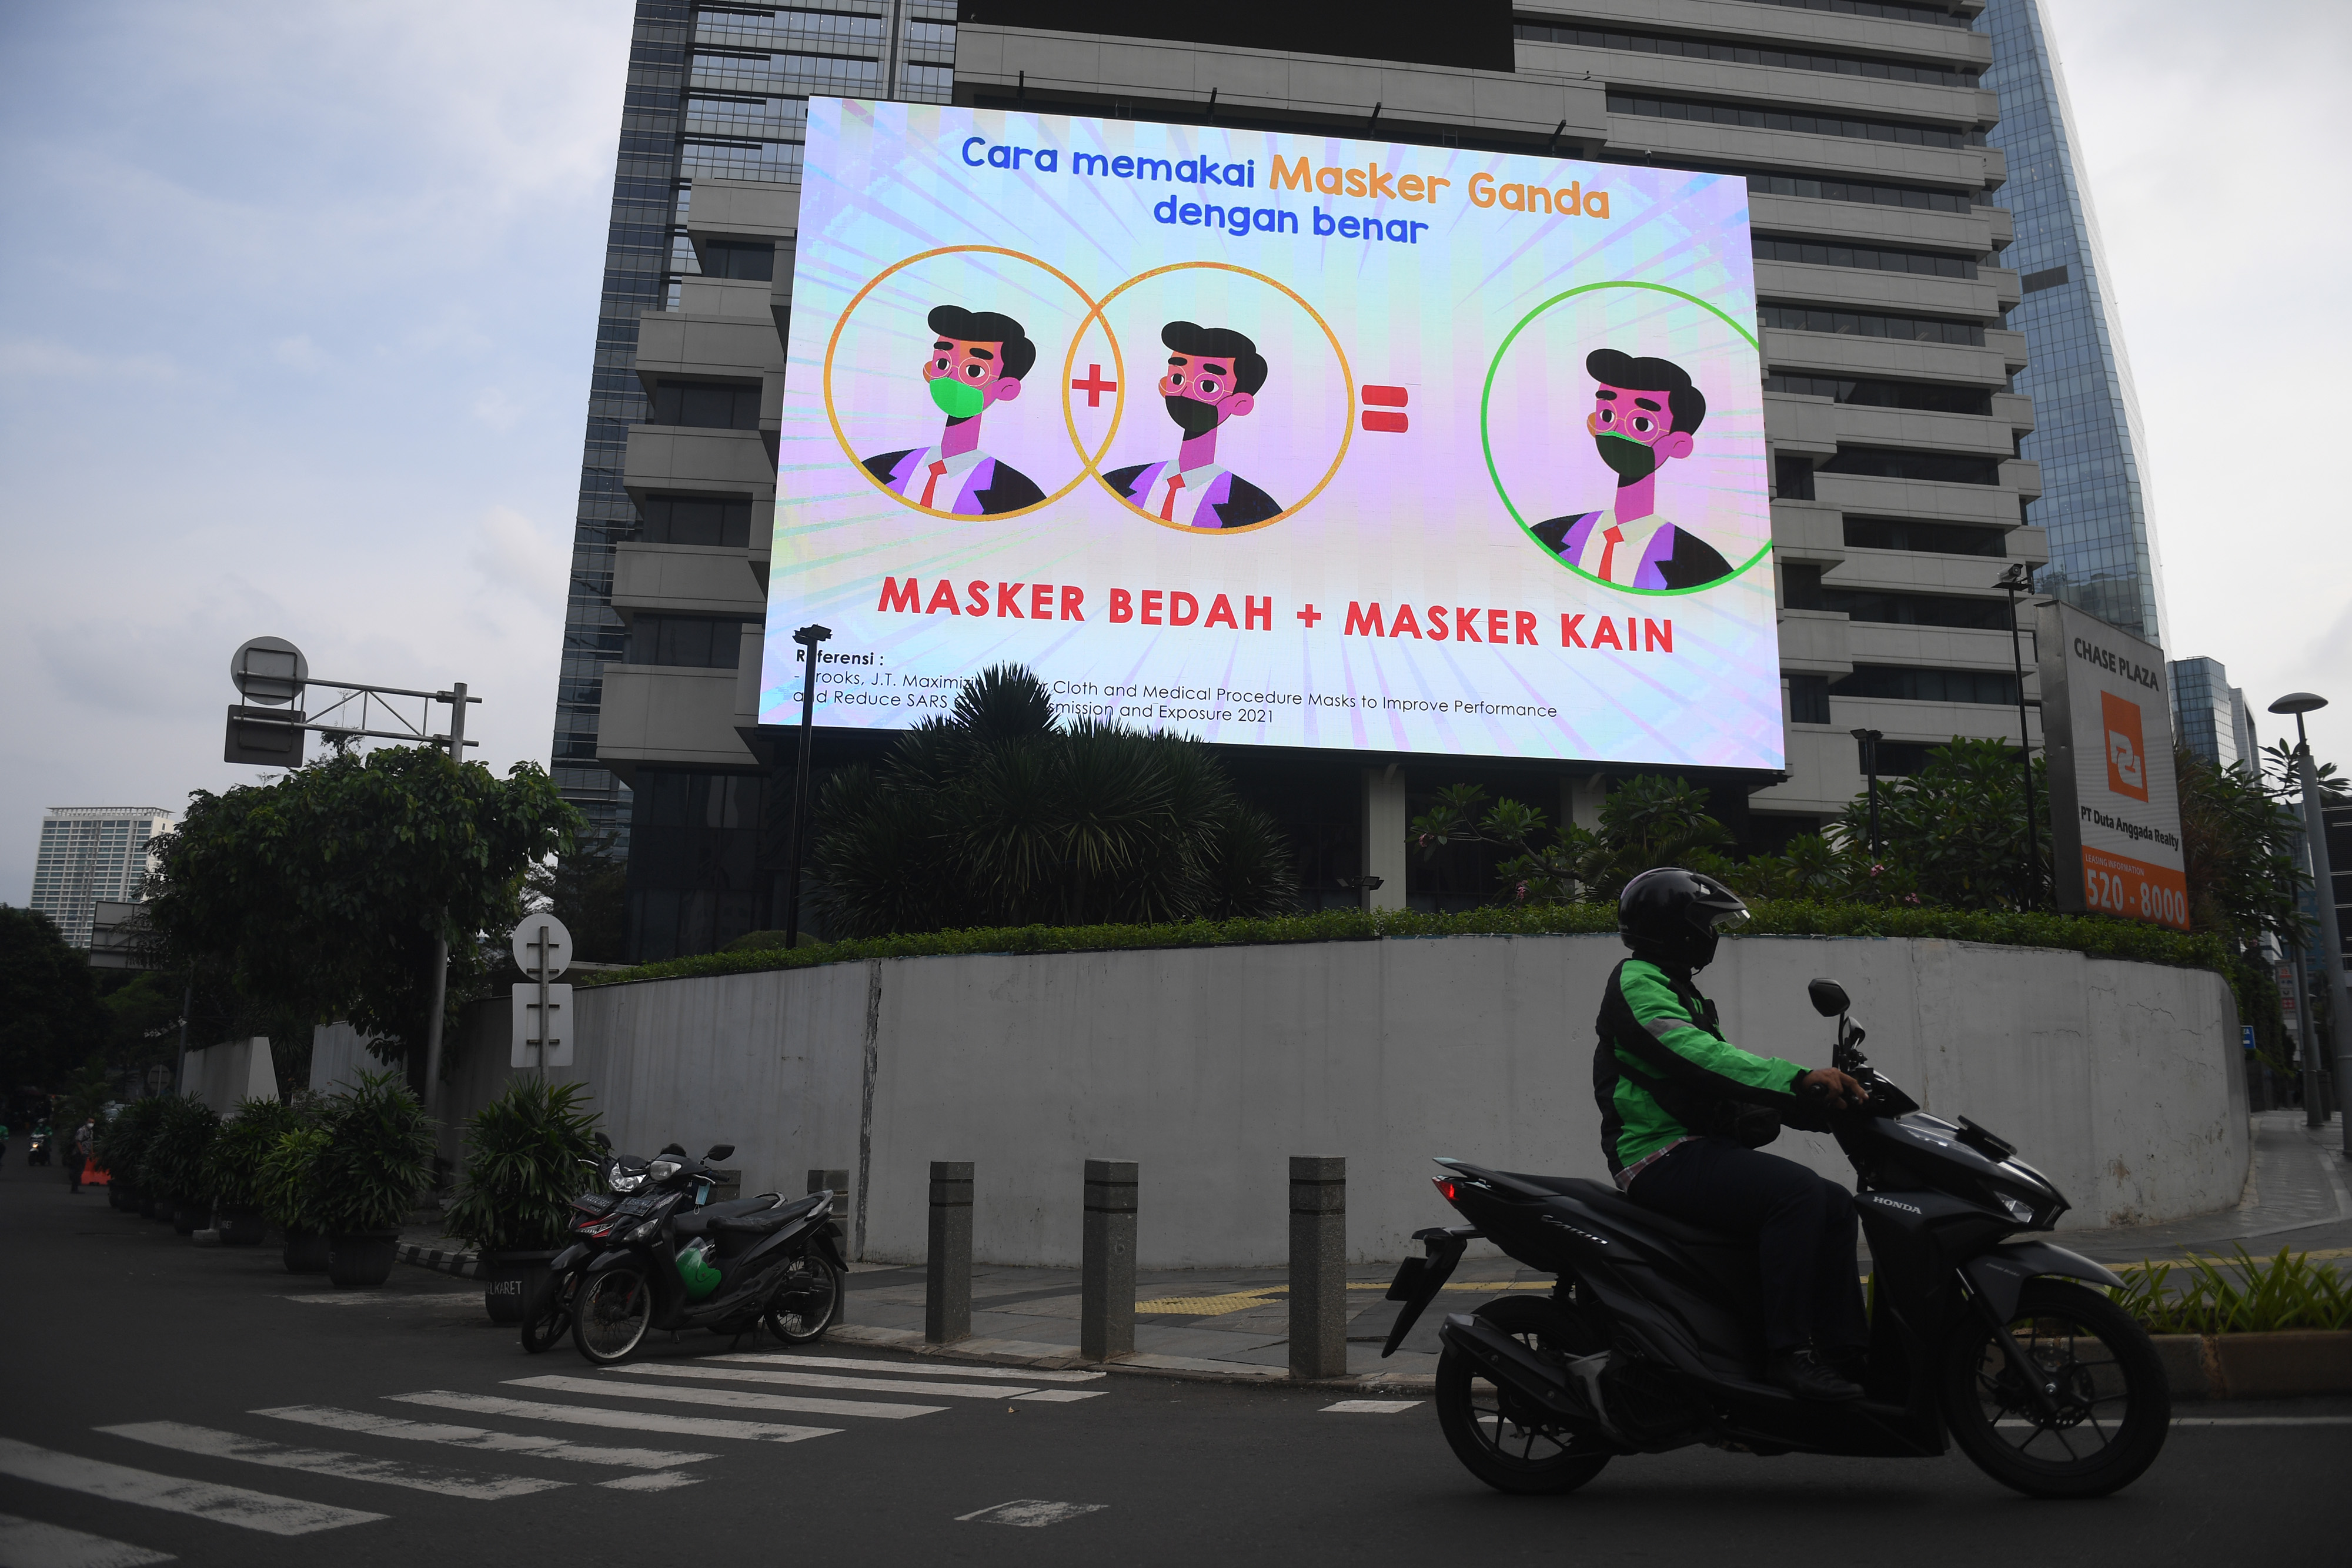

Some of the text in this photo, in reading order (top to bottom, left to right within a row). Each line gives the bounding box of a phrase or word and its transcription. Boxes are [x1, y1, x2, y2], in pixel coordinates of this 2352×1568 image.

[962, 136, 1610, 219] Cara memakai Masker Ganda
[1153, 195, 1429, 244] dengan benar
[877, 576, 1673, 653] MASKER BEDAH + MASKER KAIN
[796, 649, 874, 666] Rferensi
[2074, 637, 2160, 692] CHASE PLAZA
[793, 690, 827, 703] ad
[834, 690, 901, 706] Reduce
[907, 693, 947, 709] SARS
[1044, 700, 1113, 716] smission
[1119, 704, 1152, 717] and
[1159, 705, 1232, 721] Exposure
[1237, 708, 1273, 723] 2021
[810, 671, 865, 686] rooks,
[871, 673, 896, 686] J.T.
[903, 674, 980, 690] Maximizi
[1053, 680, 1098, 696] Cloth
[1104, 684, 1137, 697] and
[1142, 685, 1211, 701] Medical
[1217, 688, 1302, 705] Procedure
[1308, 693, 1356, 707] Masks
[1361, 695, 1378, 709] to
[1383, 696, 1449, 713] Improve
[1454, 700, 1558, 717] Performance
[2081, 805, 2179, 851] PT Duta Anggada Realty
[2085, 854, 2144, 876] LEASING INFORMATION
[2087, 868, 2124, 911] 520
[2140, 882, 2185, 925] 8000
[1872, 1196, 1923, 1215] HONDA
